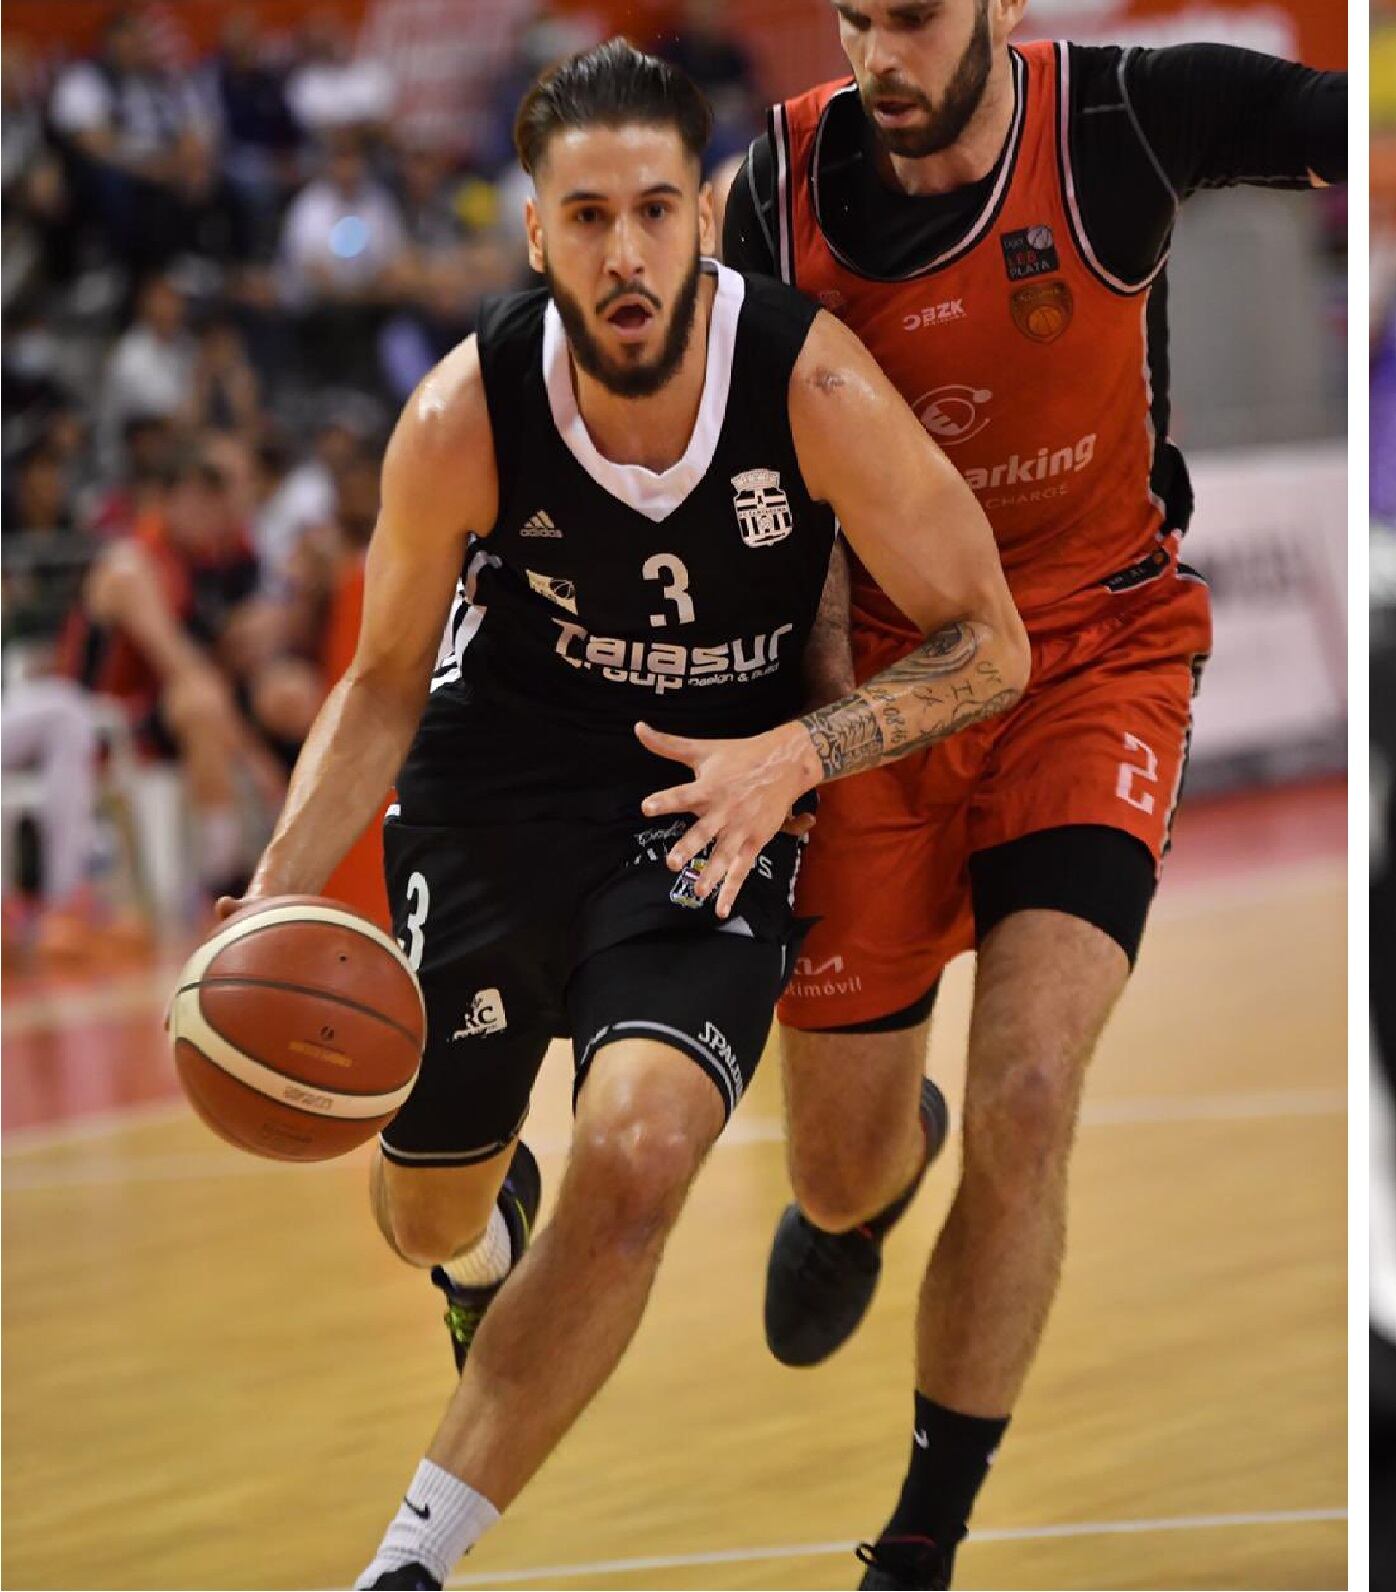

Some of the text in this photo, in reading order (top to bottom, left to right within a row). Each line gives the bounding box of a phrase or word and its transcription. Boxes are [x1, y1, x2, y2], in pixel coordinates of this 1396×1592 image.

[965, 432, 1097, 490] arking
[519, 528, 563, 538] adidas
[642, 553, 695, 627] 3
[552, 618, 793, 676] Talasur
[398, 871, 429, 971] 3
[784, 976, 862, 997] kimóvil
